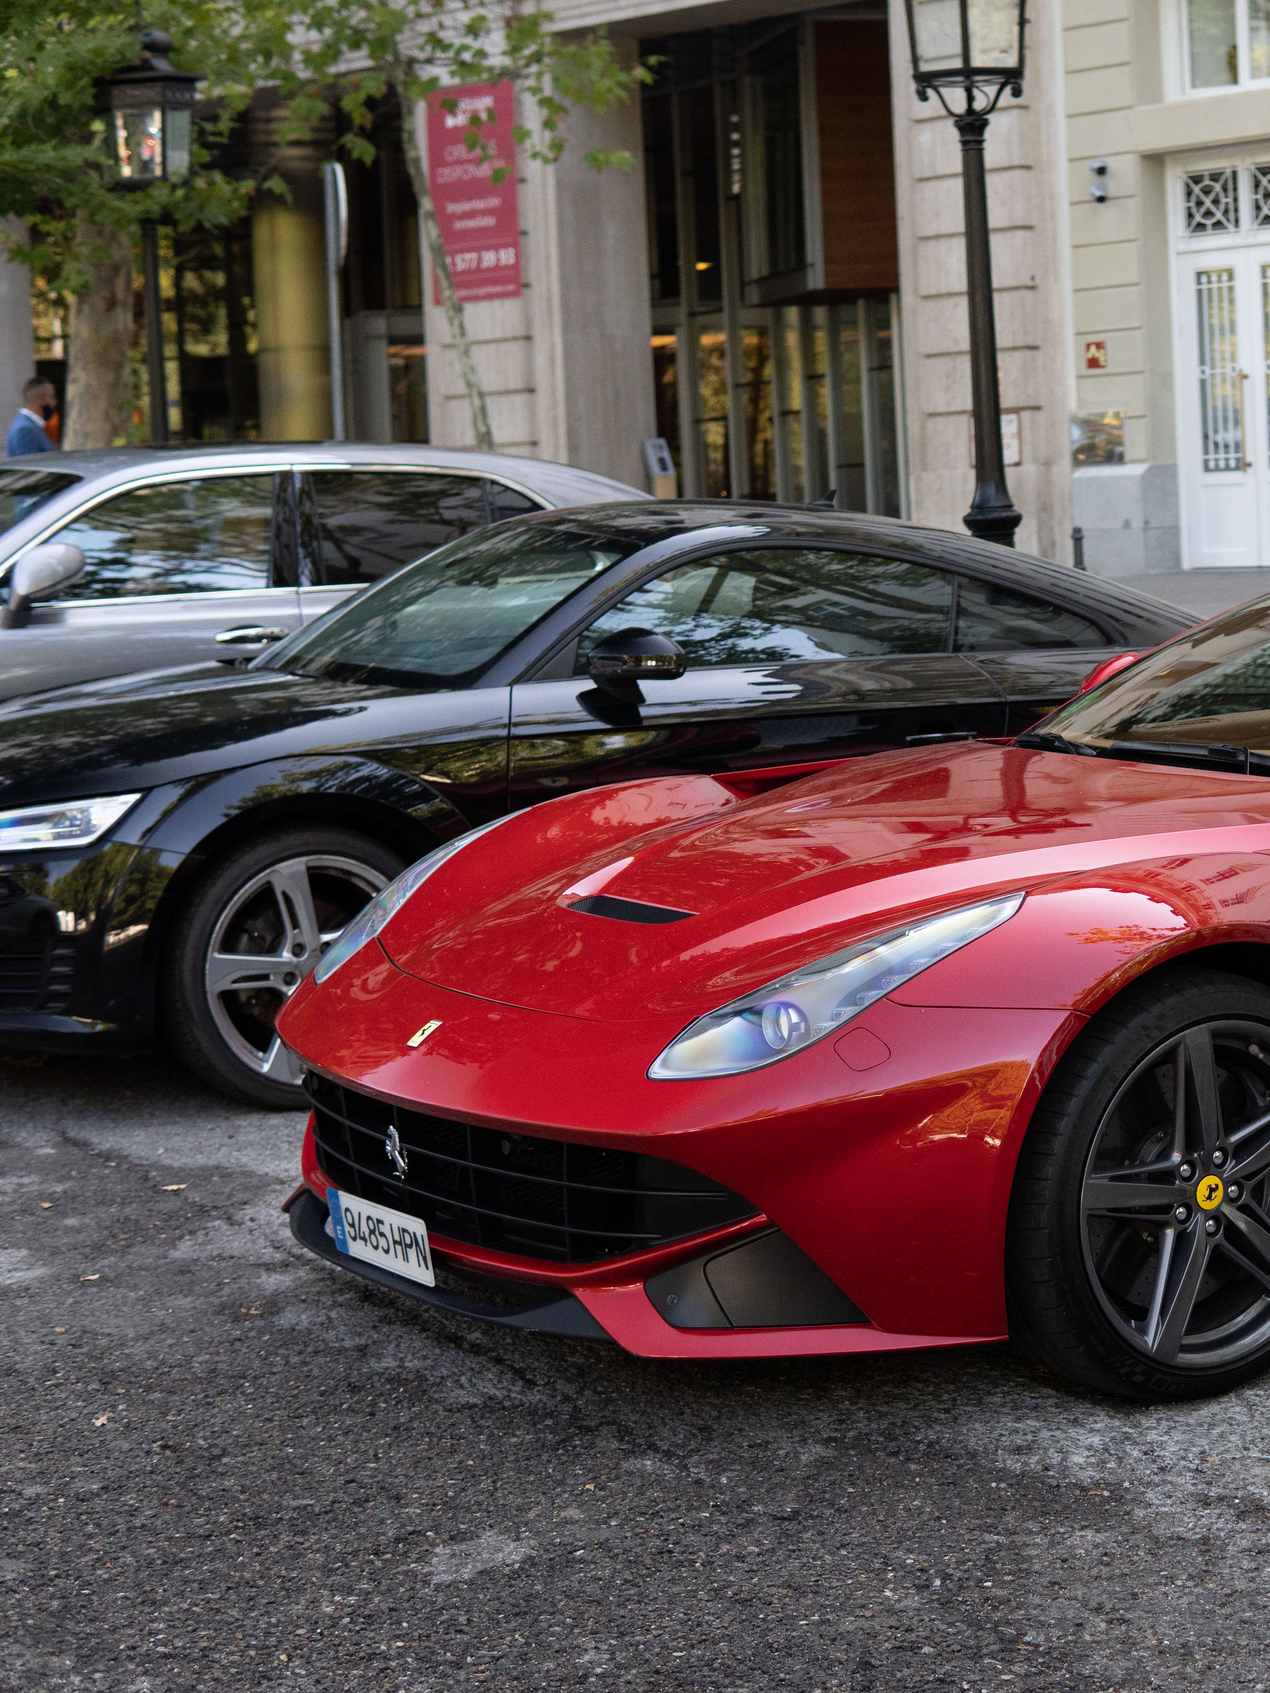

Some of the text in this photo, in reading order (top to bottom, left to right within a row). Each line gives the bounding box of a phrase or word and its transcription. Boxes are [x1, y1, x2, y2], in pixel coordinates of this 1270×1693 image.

[454, 251, 479, 272] 577
[336, 1207, 430, 1271] E 9485 HPN
